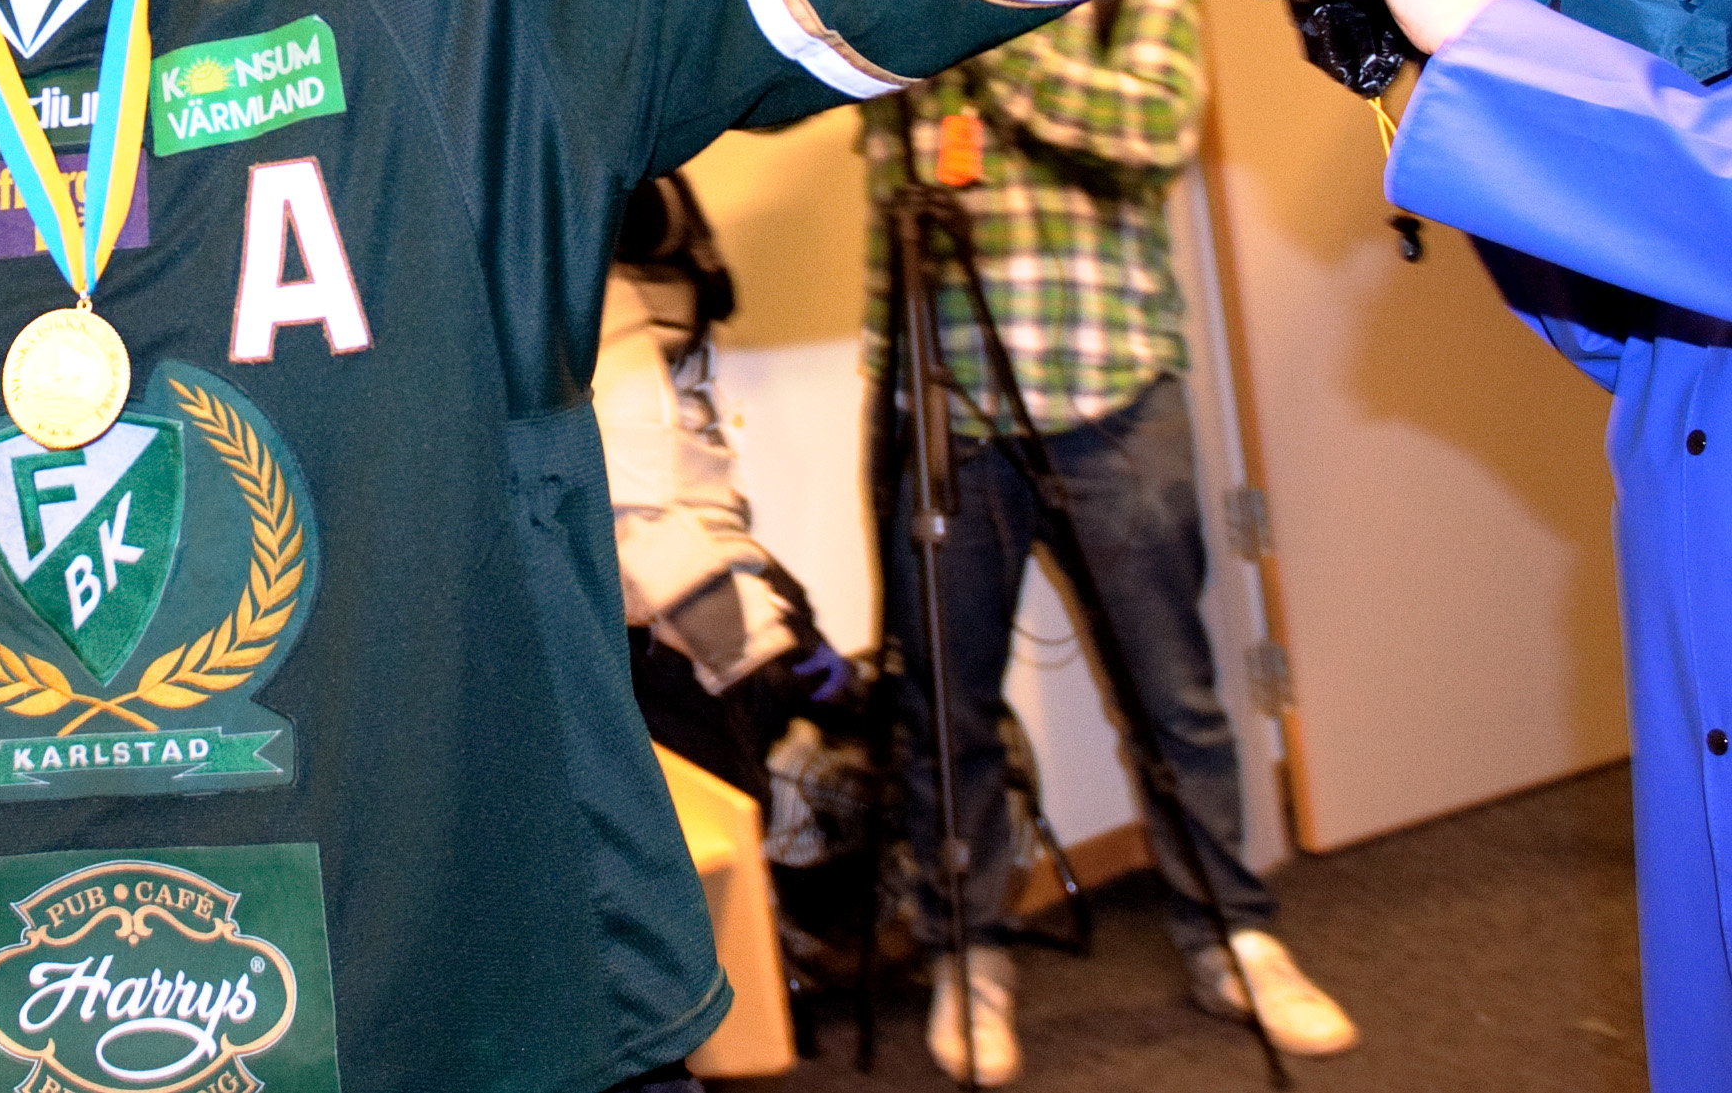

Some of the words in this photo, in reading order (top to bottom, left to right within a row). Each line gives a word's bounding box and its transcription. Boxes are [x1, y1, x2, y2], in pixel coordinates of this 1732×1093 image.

[167, 76, 325, 140] VÄRMLAND
[229, 156, 373, 362] A
[13, 737, 210, 772] KARLSTAD
[46, 885, 107, 928] PUB
[135, 880, 216, 922] CAFÉ
[18, 954, 257, 1080] Harrys
